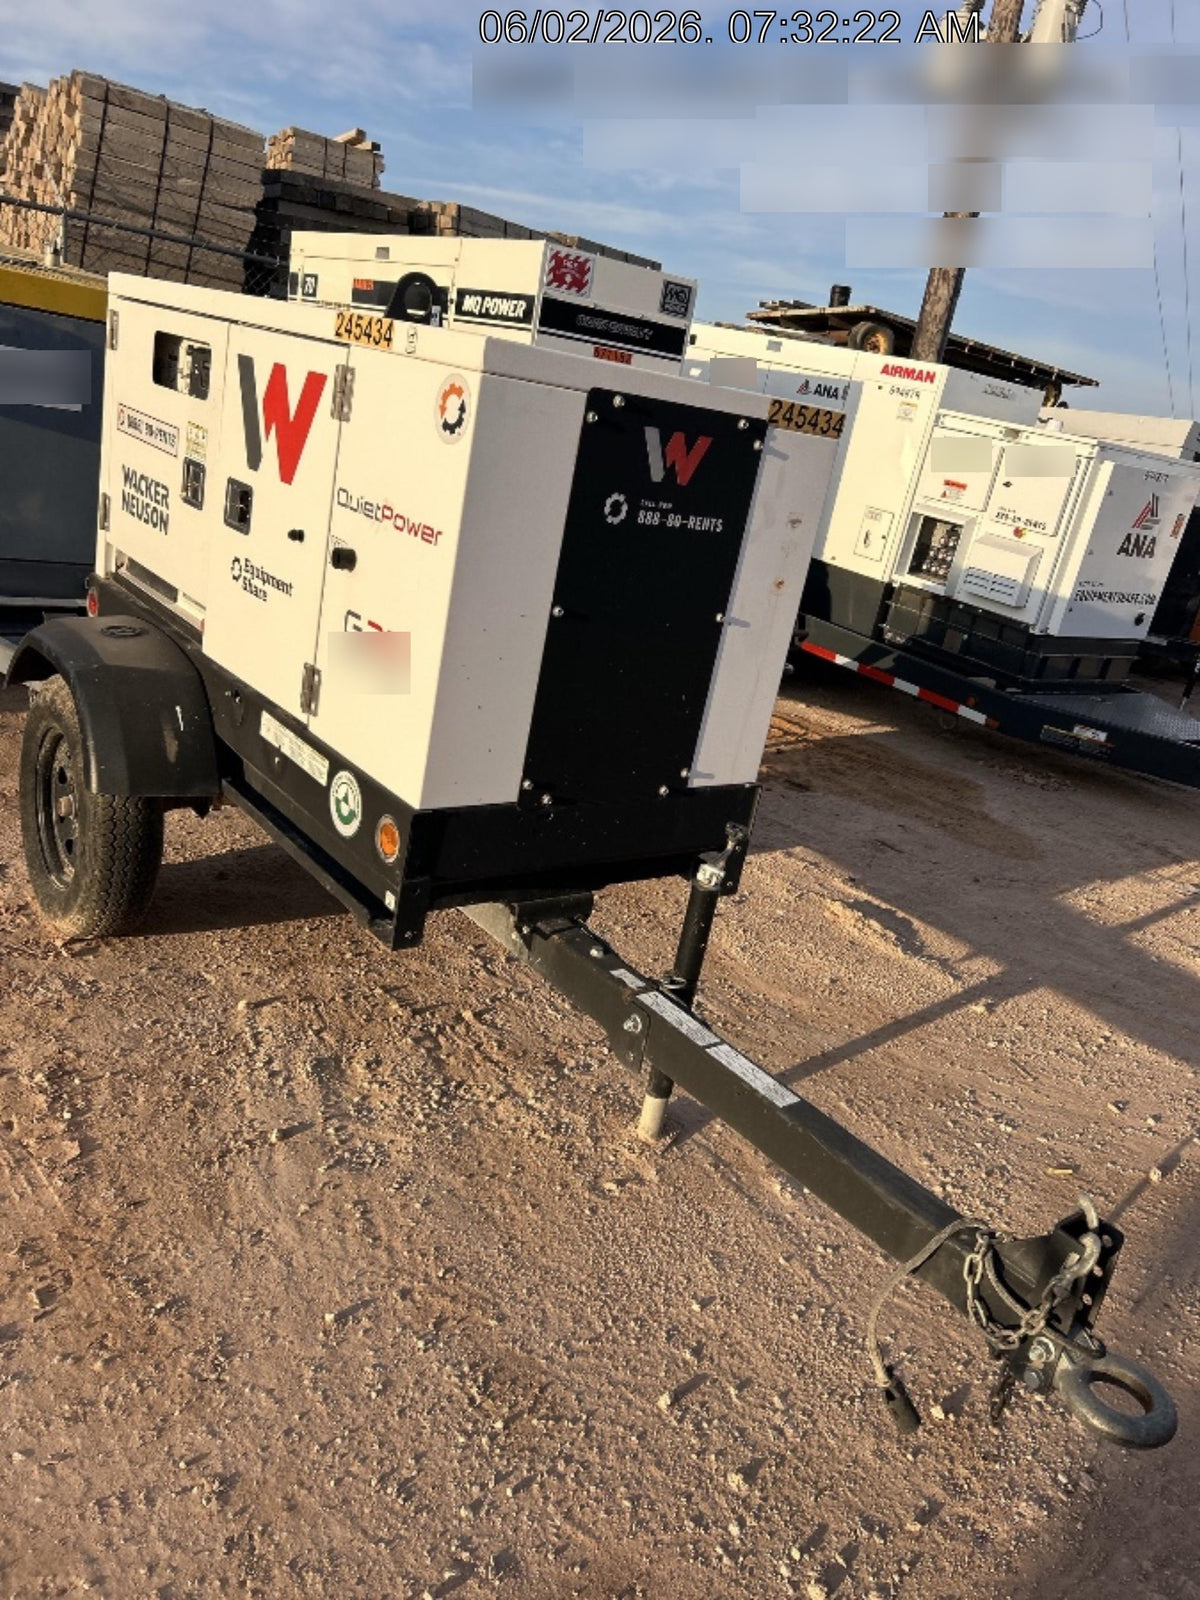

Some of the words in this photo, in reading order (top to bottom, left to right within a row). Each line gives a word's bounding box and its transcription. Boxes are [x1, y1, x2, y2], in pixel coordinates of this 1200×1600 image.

[462, 294, 482, 316] MQ
[482, 295, 528, 319] POWER
[334, 311, 394, 348] 245434
[880, 363, 936, 384] AIRMAN
[813, 383, 839, 400] ANA
[768, 399, 847, 438] 245434
[122, 463, 169, 510] WACKER
[122, 489, 169, 535] NEUSON
[337, 487, 443, 547] QuietPower
[638, 509, 723, 533] 888-80-RENTS
[1116, 532, 1157, 559] ANA
[242, 576, 268, 602] Share
[243, 558, 294, 597] Equipment
